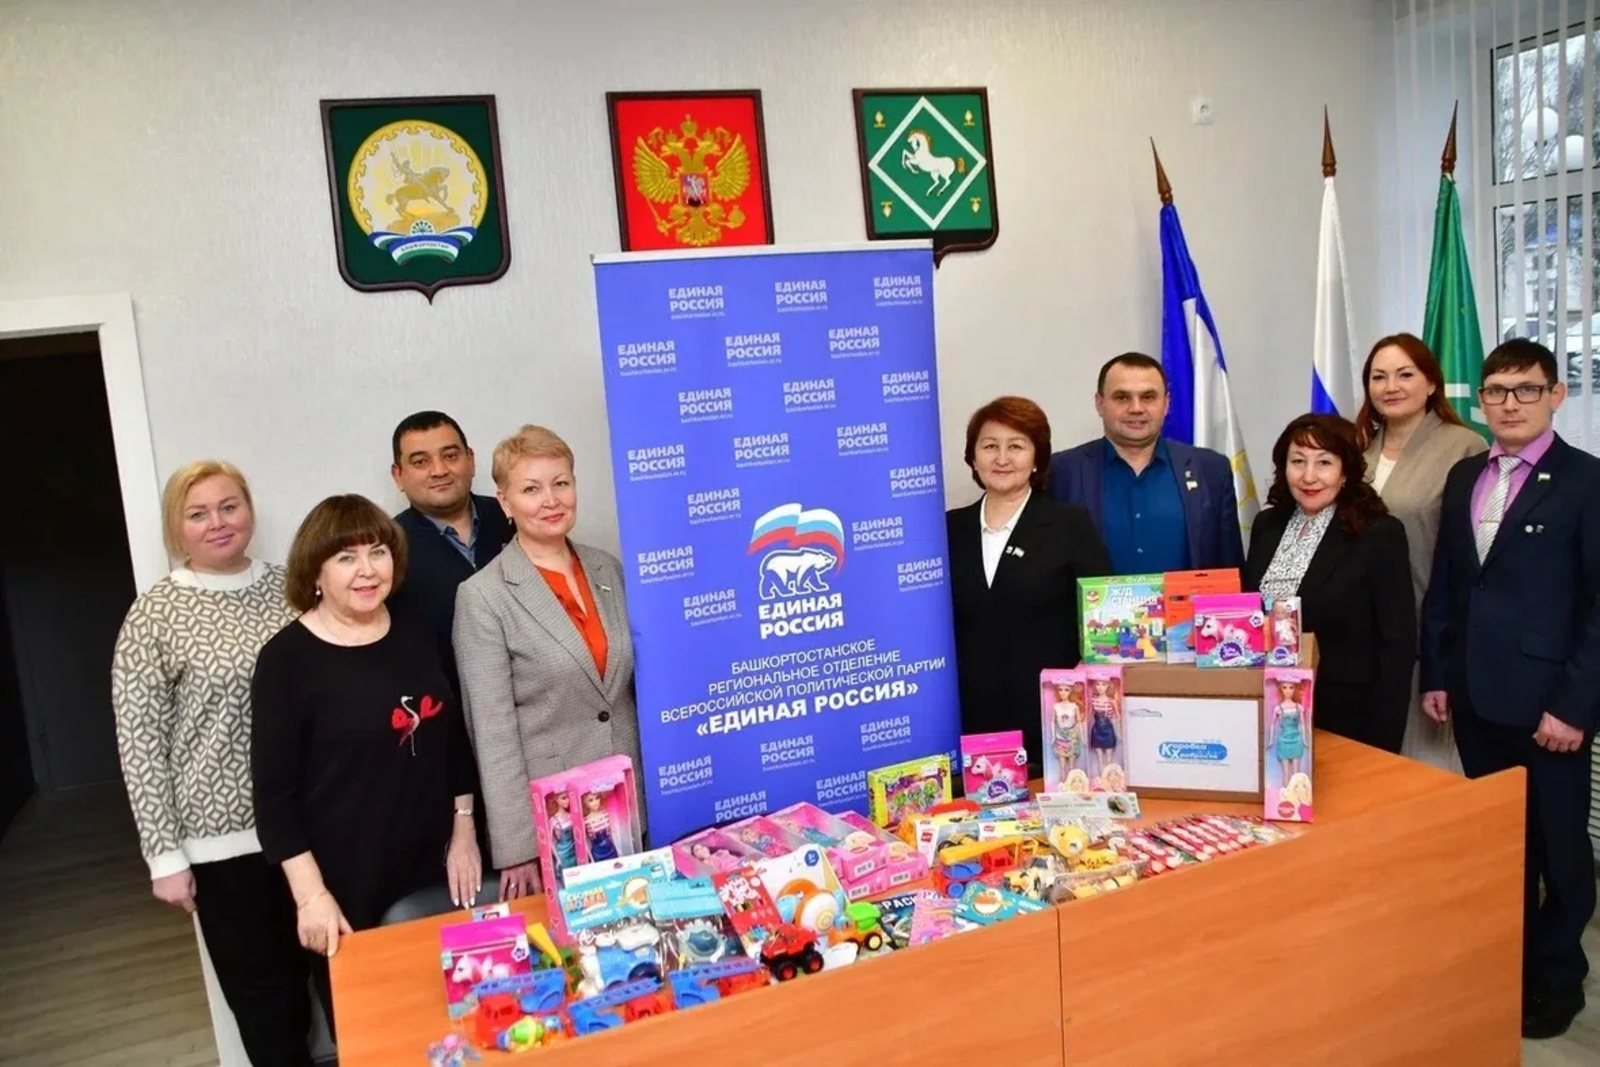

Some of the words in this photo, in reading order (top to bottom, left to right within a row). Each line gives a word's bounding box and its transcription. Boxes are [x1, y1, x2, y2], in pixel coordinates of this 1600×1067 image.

[775, 280, 826, 293] ЕДИНАЯ
[874, 276, 921, 287] ЕДИНАЯ
[669, 286, 722, 299] ЕДИНАЯ
[776, 292, 827, 305] РОССИЯ
[875, 287, 922, 299] РОССИЯ
[670, 298, 724, 311] РОССИЯ
[725, 333, 780, 347] ЕДИНАЯ
[829, 326, 878, 339] ЕДИНАЯ
[618, 341, 675, 356] ЕДИНАЯ
[727, 345, 781, 359] РОССИЯ
[830, 338, 880, 351] РОССИЯ
[619, 353, 676, 368] РОССИЯ
[882, 371, 928, 384] ЕДИНАЯ
[784, 379, 834, 393] ЕДИНАЯ
[883, 383, 930, 396] РОССИЯ
[679, 388, 731, 403] ЕДИНАЯ
[785, 391, 835, 405] РОССИЯ
[680, 400, 732, 415] РОССИЯ
[837, 423, 887, 437] ЕДИНАЯ
[734, 433, 788, 448] ЕДИНАЯ
[838, 434, 888, 449] РОССИЯ
[628, 444, 684, 460] ЕДИНАЯ
[735, 445, 789, 460] РОССИЯ
[629, 457, 685, 473] РОССИЯ
[890, 464, 935, 479] ЕДИНАЯ
[891, 476, 936, 490] РОССИЯ
[688, 488, 740, 505] ЕДИНАЯ
[689, 500, 740, 517] РОССИЯ
[852, 517, 902, 532] ЕДИНАЯ
[853, 528, 903, 544] РОССИЯ
[638, 546, 692, 563] ЕДИНАЯ
[639, 558, 694, 576] РОССИЯ
[898, 557, 942, 573] ЕДИНАЯ
[898, 569, 943, 585] РОССИЯ
[684, 589, 735, 608] ЕДИНАЯ
[759, 593, 842, 620] ЕДИНАЯ
[685, 601, 736, 619] РОССИЯ
[760, 611, 844, 639] РОССИЯ
[732, 639, 875, 674] БАШКОРТОСТАНСКОЕ
[709, 665, 819, 695] РЕГИОНАЛЬНОЕ
[823, 650, 900, 675] ОТДЕЛЕНИЕ
[661, 687, 783, 723] ВСЕРОССИЙСКОЙ
[787, 668, 893, 696] ПОЛИТИЧЕСКОЙ
[897, 657, 945, 675] ПАРТИИ
[696, 699, 806, 736] «ЕДИНАЯ
[815, 680, 918, 713] РОССИЯ»
[861, 716, 910, 734] ЕДИНАЯ
[862, 726, 910, 745] РОССИЯ
[760, 735, 813, 753] ЕДИНАЯ
[762, 747, 814, 765] РОССИЯ
[658, 756, 711, 777] ЕДИНАЯ
[660, 767, 712, 788] РОССИЯ
[816, 771, 865, 789] ЕДИНАЯ
[817, 781, 866, 801] РОССИЯ
[715, 790, 766, 811] ЕДИНАЯ
[716, 802, 767, 822] РОССИЯ
